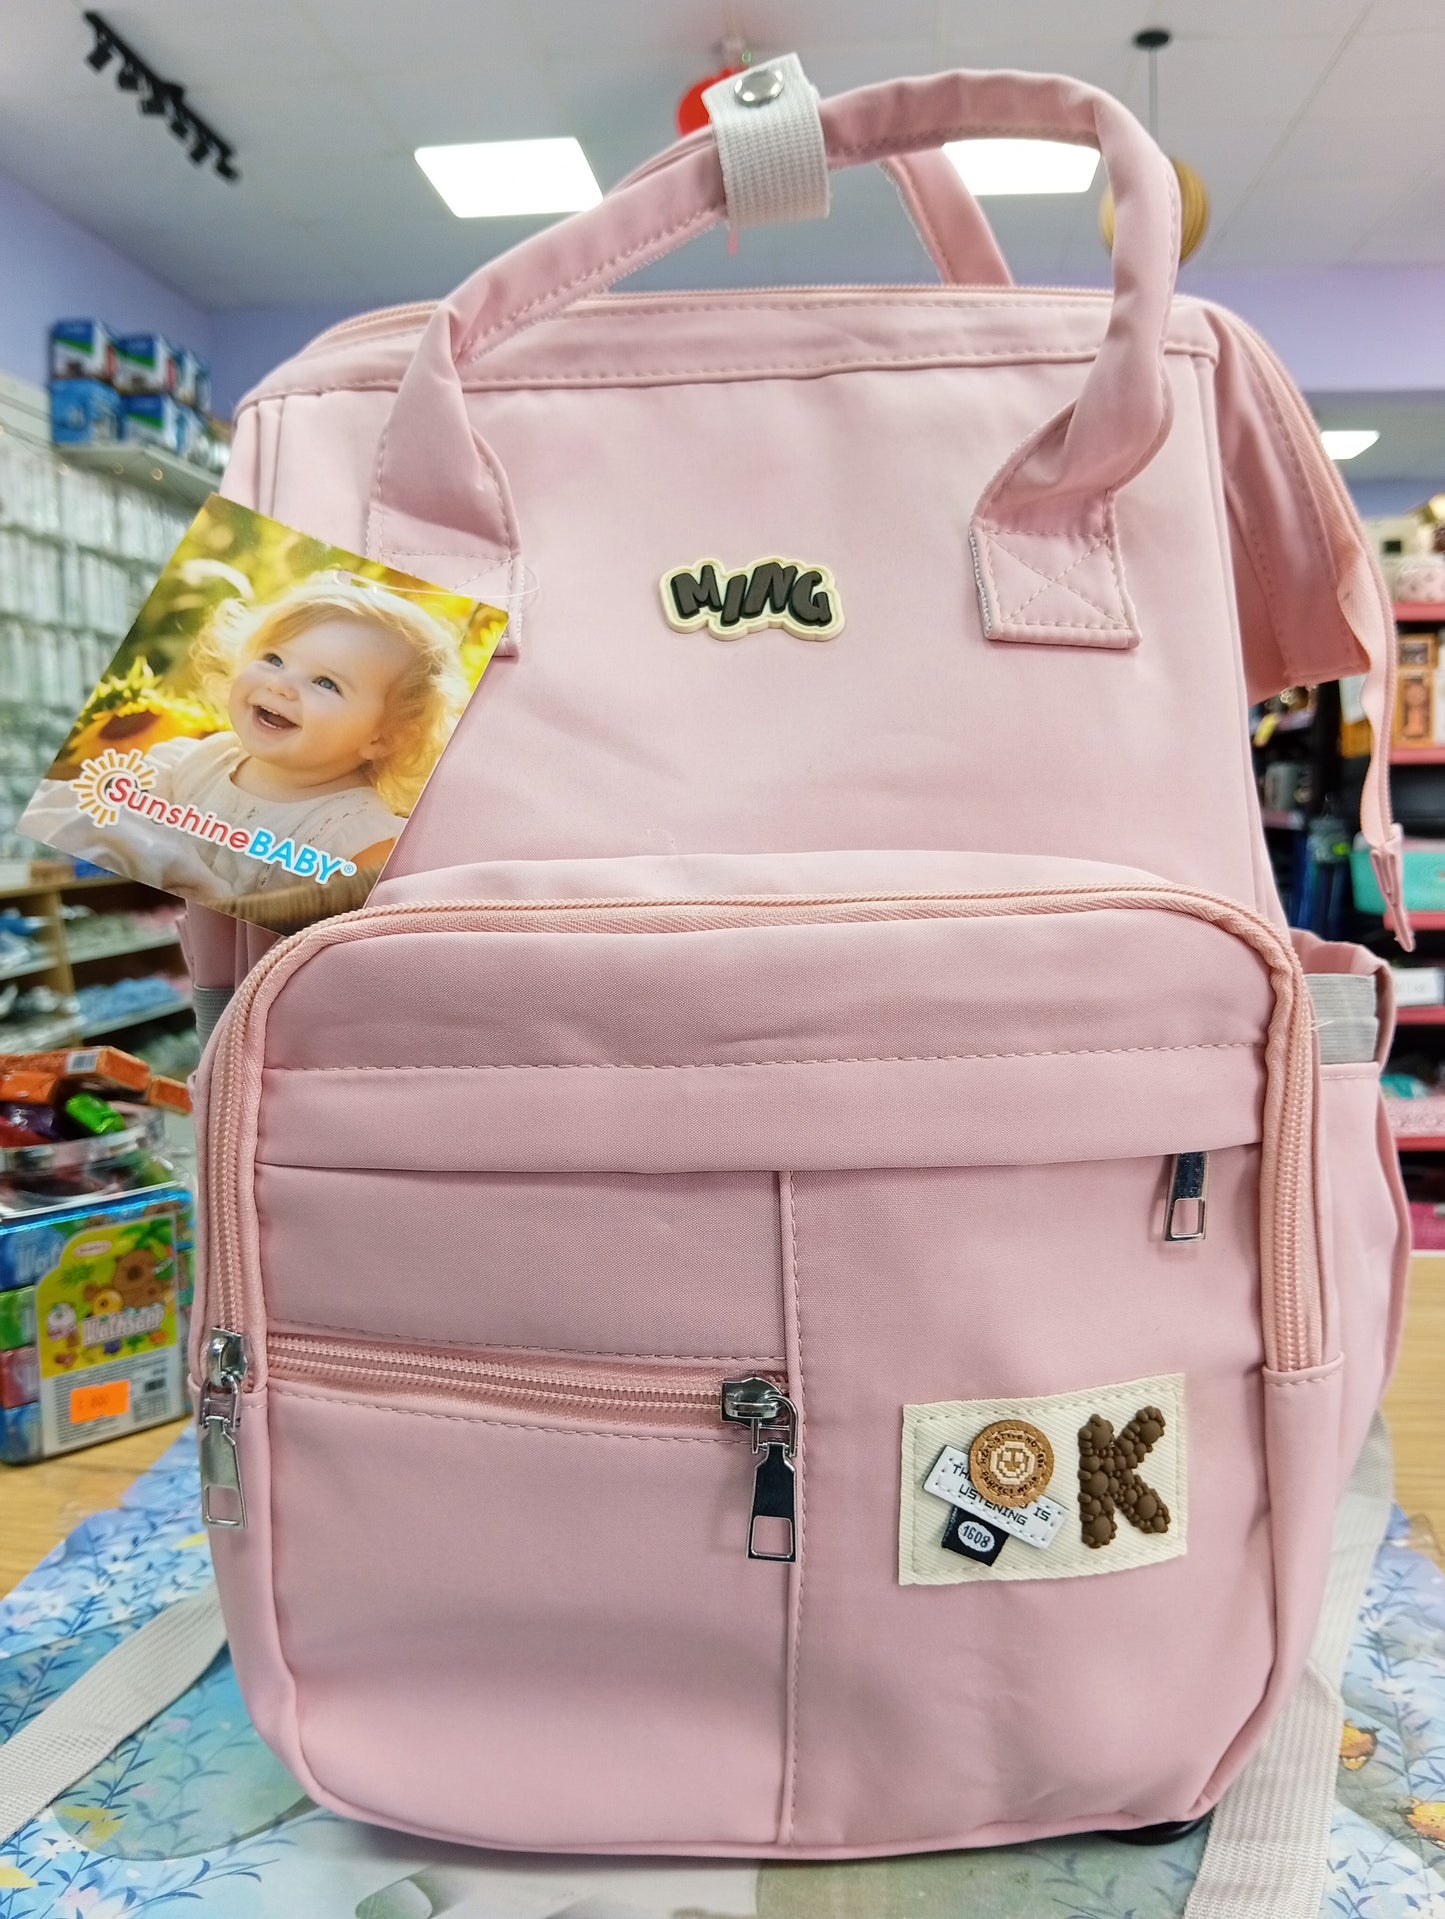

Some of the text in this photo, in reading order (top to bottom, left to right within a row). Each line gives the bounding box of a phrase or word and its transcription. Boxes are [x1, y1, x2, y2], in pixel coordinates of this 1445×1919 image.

[670, 561, 833, 627] MING
[1033, 1506, 1051, 1522] IS
[962, 1524, 992, 1548] 1608
